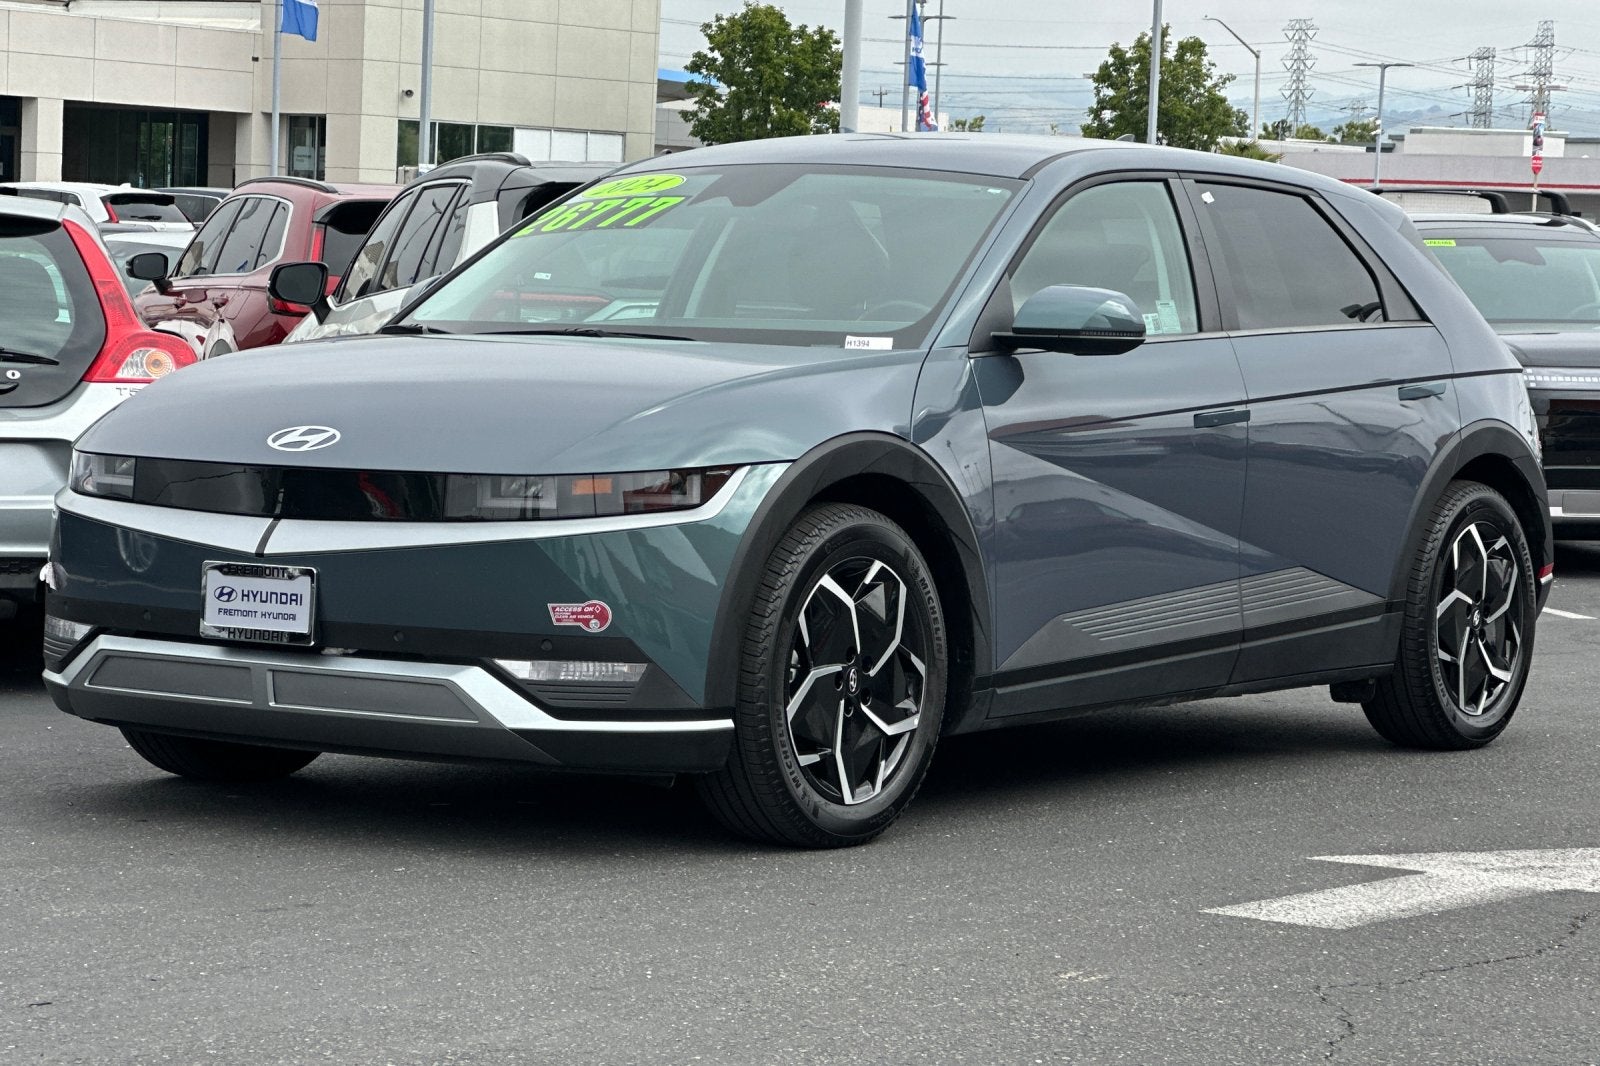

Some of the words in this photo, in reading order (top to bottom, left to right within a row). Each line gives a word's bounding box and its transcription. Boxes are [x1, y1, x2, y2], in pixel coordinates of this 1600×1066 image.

[512, 197, 685, 238] 26777
[241, 589, 303, 606] HYUNDAI
[217, 608, 258, 618] FREMONT
[260, 611, 297, 621] HYUNDAI
[920, 577, 944, 655] MICHELIN
[227, 626, 284, 641] HYUNDAI
[775, 708, 802, 789] MICHELIN
